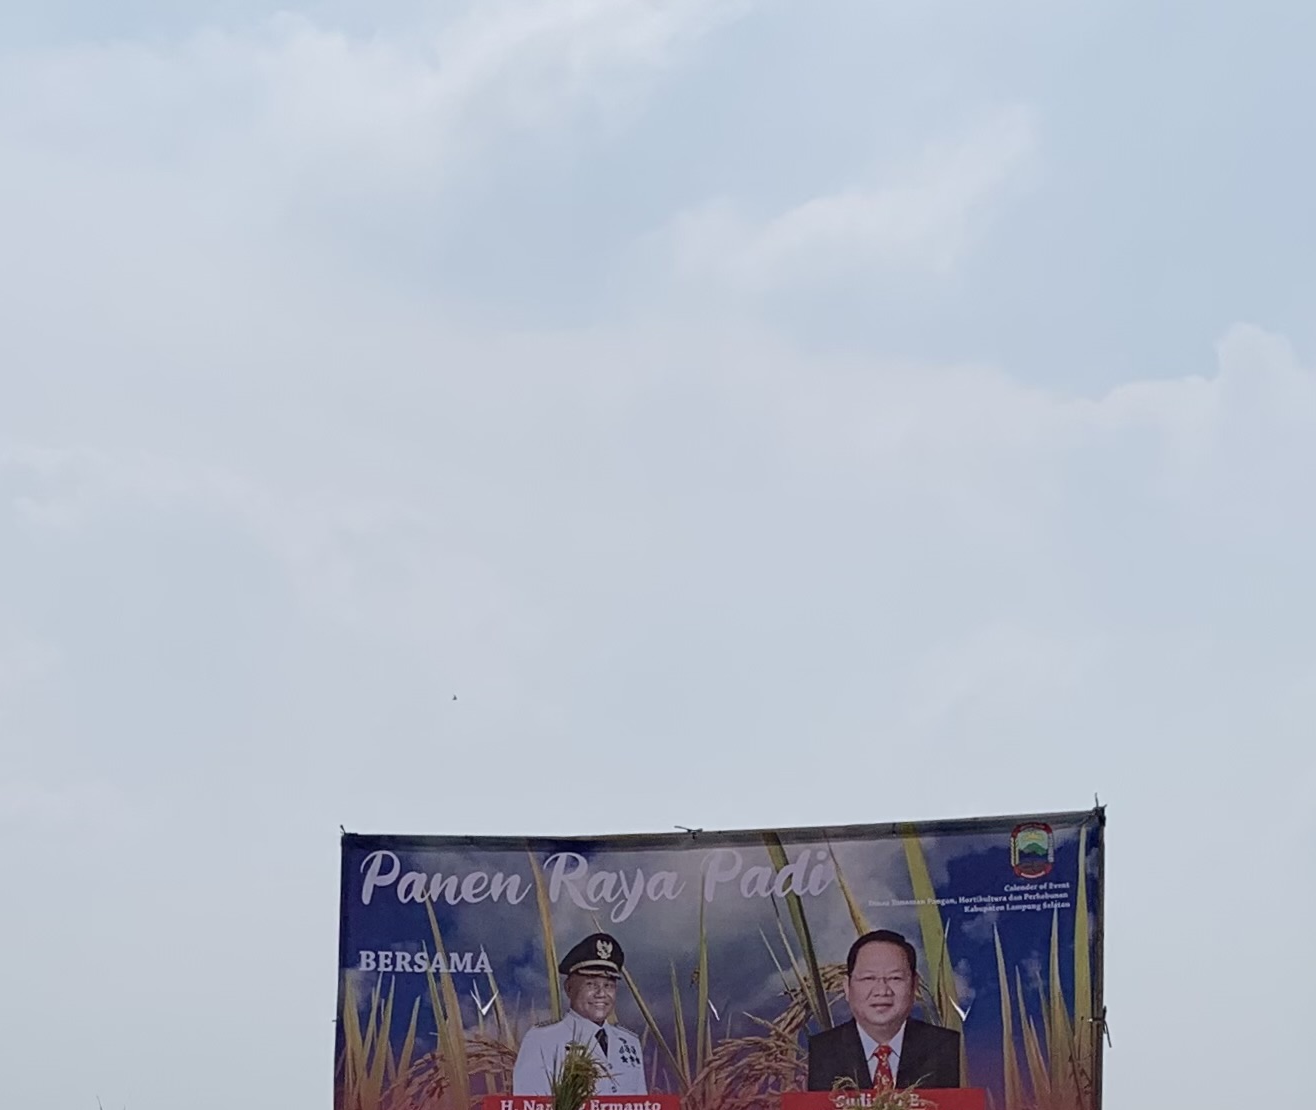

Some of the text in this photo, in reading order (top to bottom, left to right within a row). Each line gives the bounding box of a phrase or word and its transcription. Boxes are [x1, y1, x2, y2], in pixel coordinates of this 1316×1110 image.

[360, 849, 835, 923] Panen Raya Padi
[1039, 882, 1047, 891] of
[1049, 881, 1071, 890] Event
[958, 895, 1007, 905] Hortikultura
[1008, 893, 1023, 901] dan
[1024, 891, 1069, 901] Perkebunan
[964, 900, 1071, 914] Kabupaten Lampung Selatan
[359, 950, 493, 973] BERSAMA
